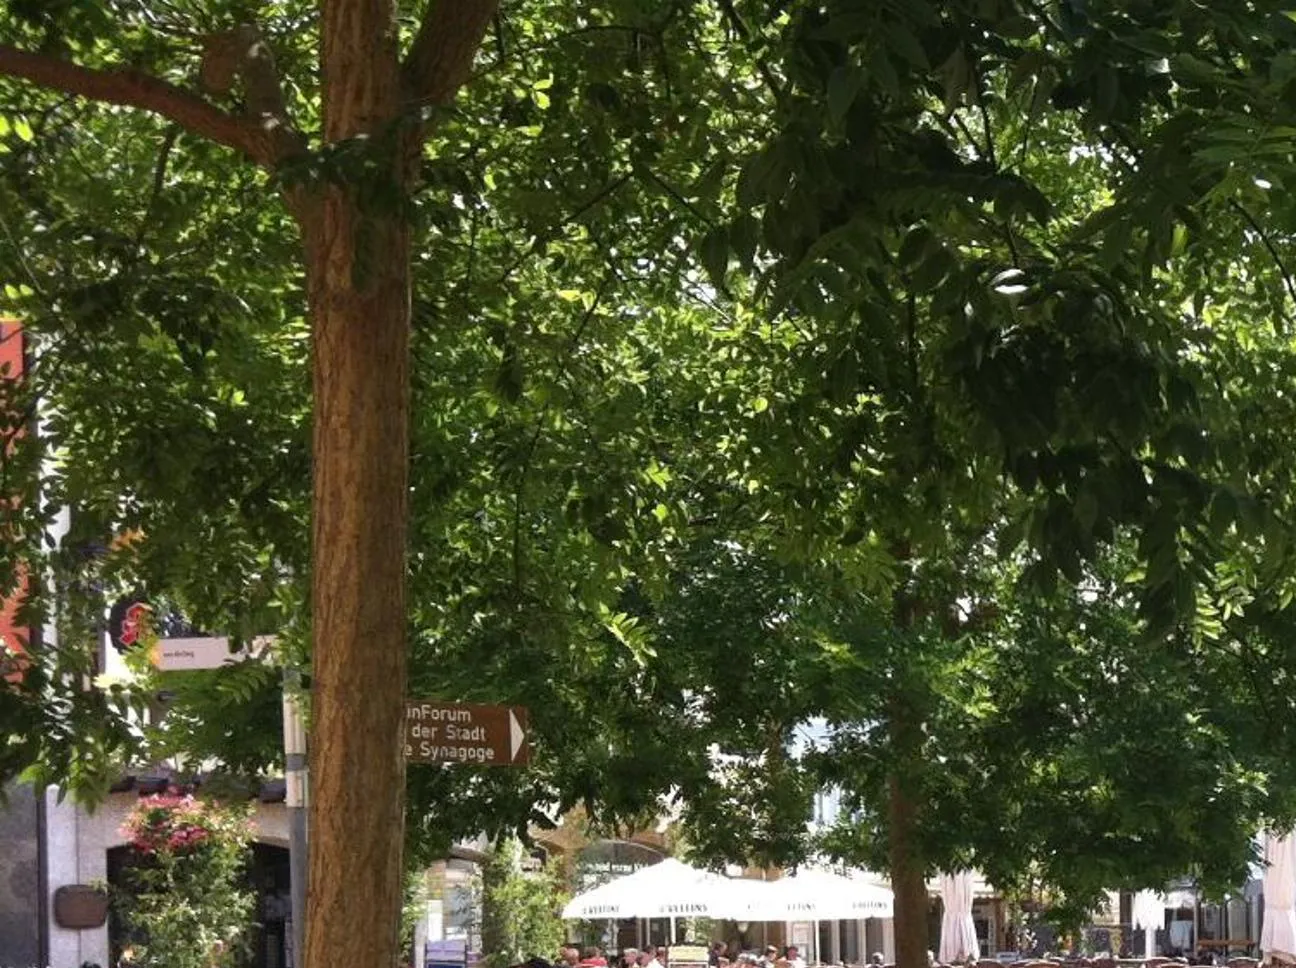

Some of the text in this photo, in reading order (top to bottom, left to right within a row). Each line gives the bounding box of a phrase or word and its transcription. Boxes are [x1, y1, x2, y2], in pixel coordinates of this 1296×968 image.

[411, 723, 486, 741] der Stadt
[420, 740, 495, 762] Synagoge
